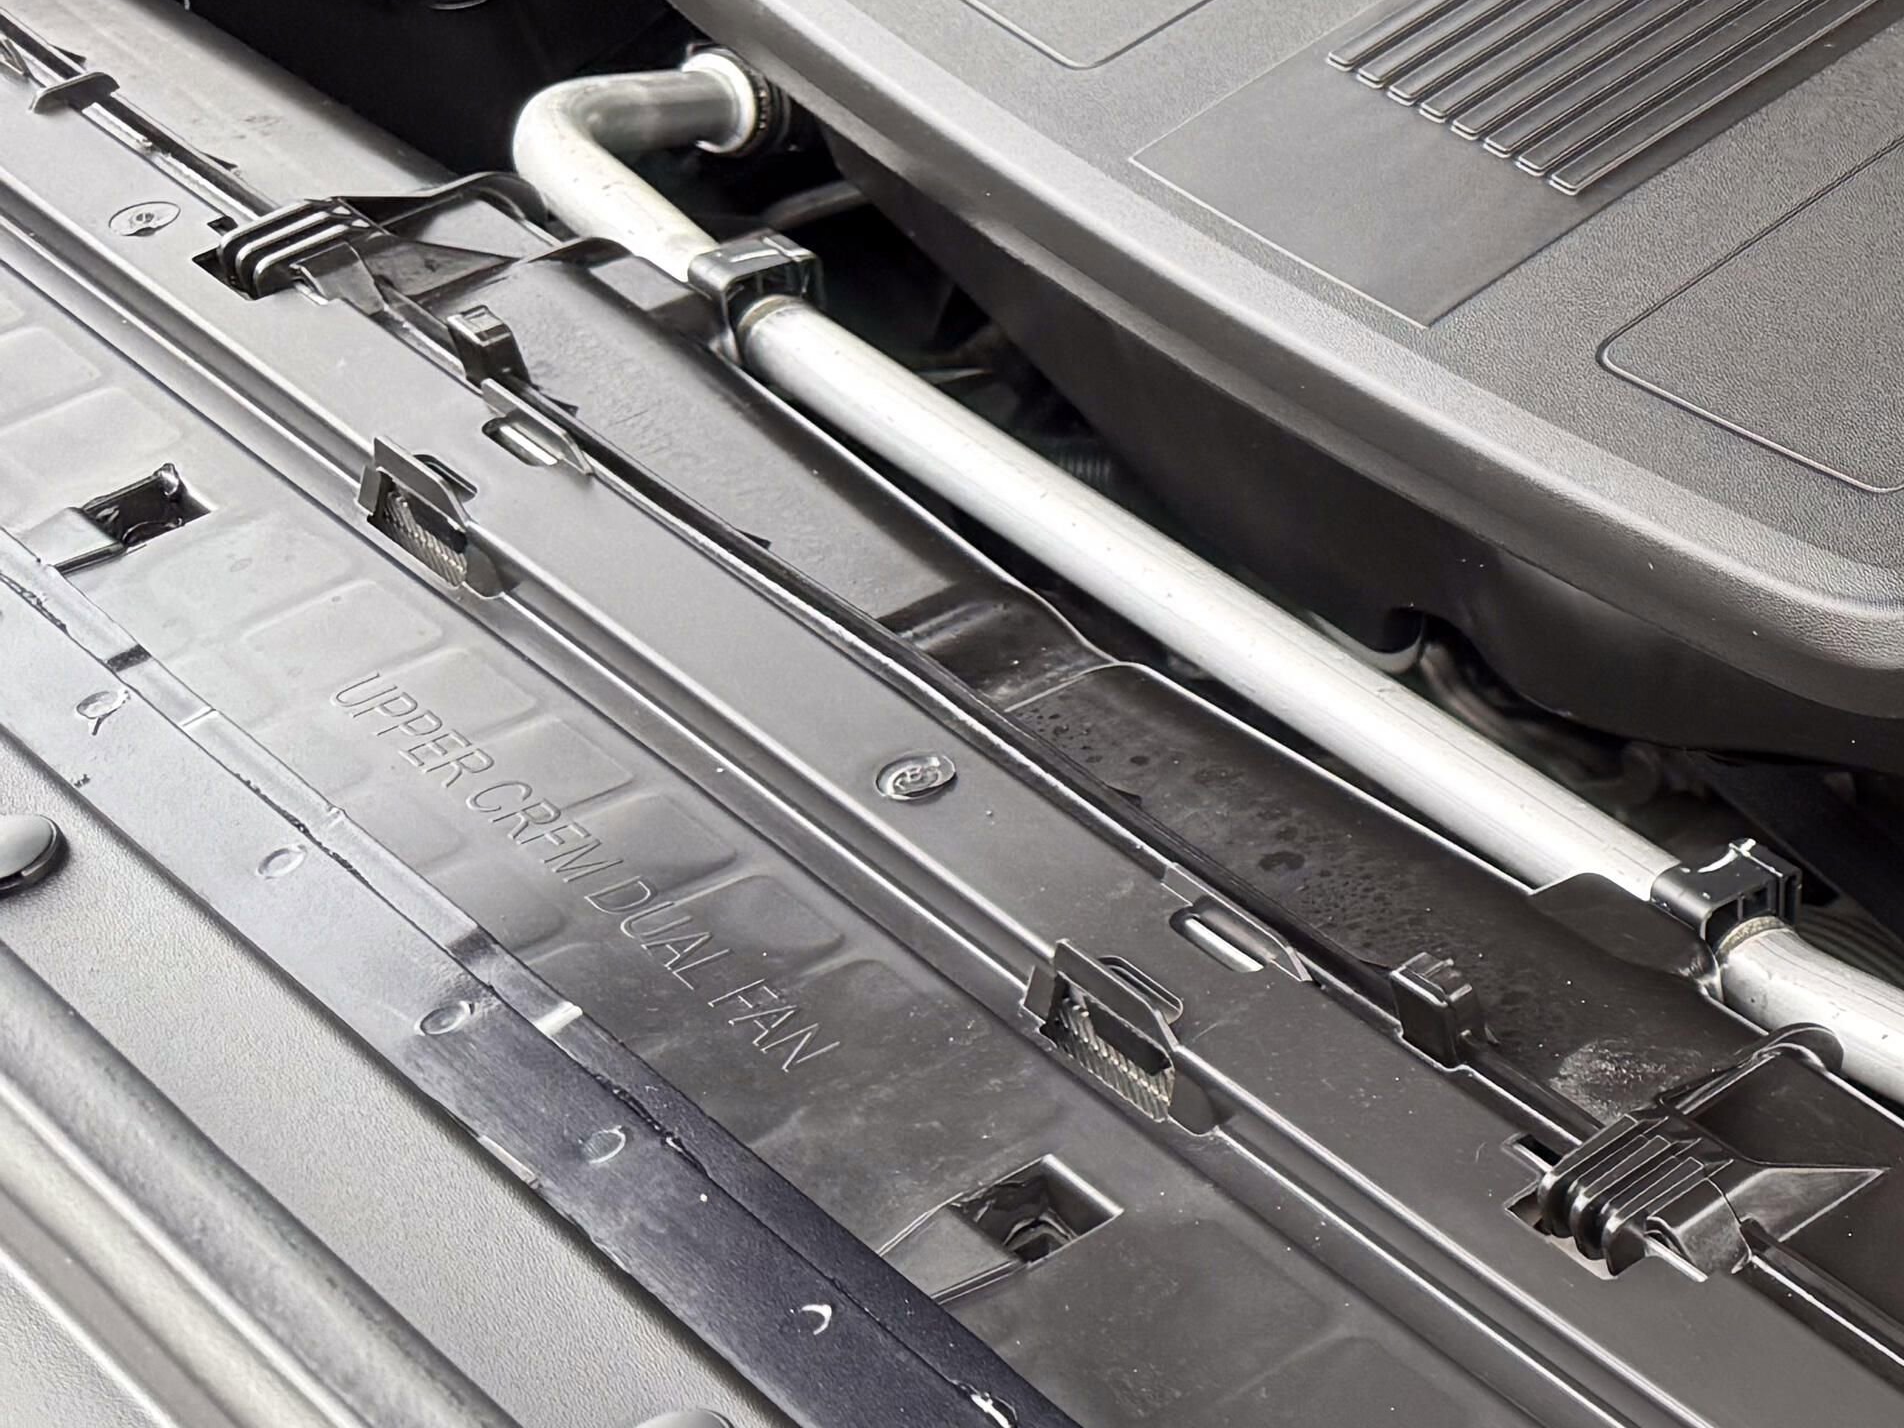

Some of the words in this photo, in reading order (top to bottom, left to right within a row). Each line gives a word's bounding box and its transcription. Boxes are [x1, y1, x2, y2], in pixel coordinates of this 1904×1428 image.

[329, 671, 495, 788] UPPER
[465, 779, 625, 884] CRFM
[583, 875, 733, 991] DUAL
[707, 978, 841, 1073] FAN
